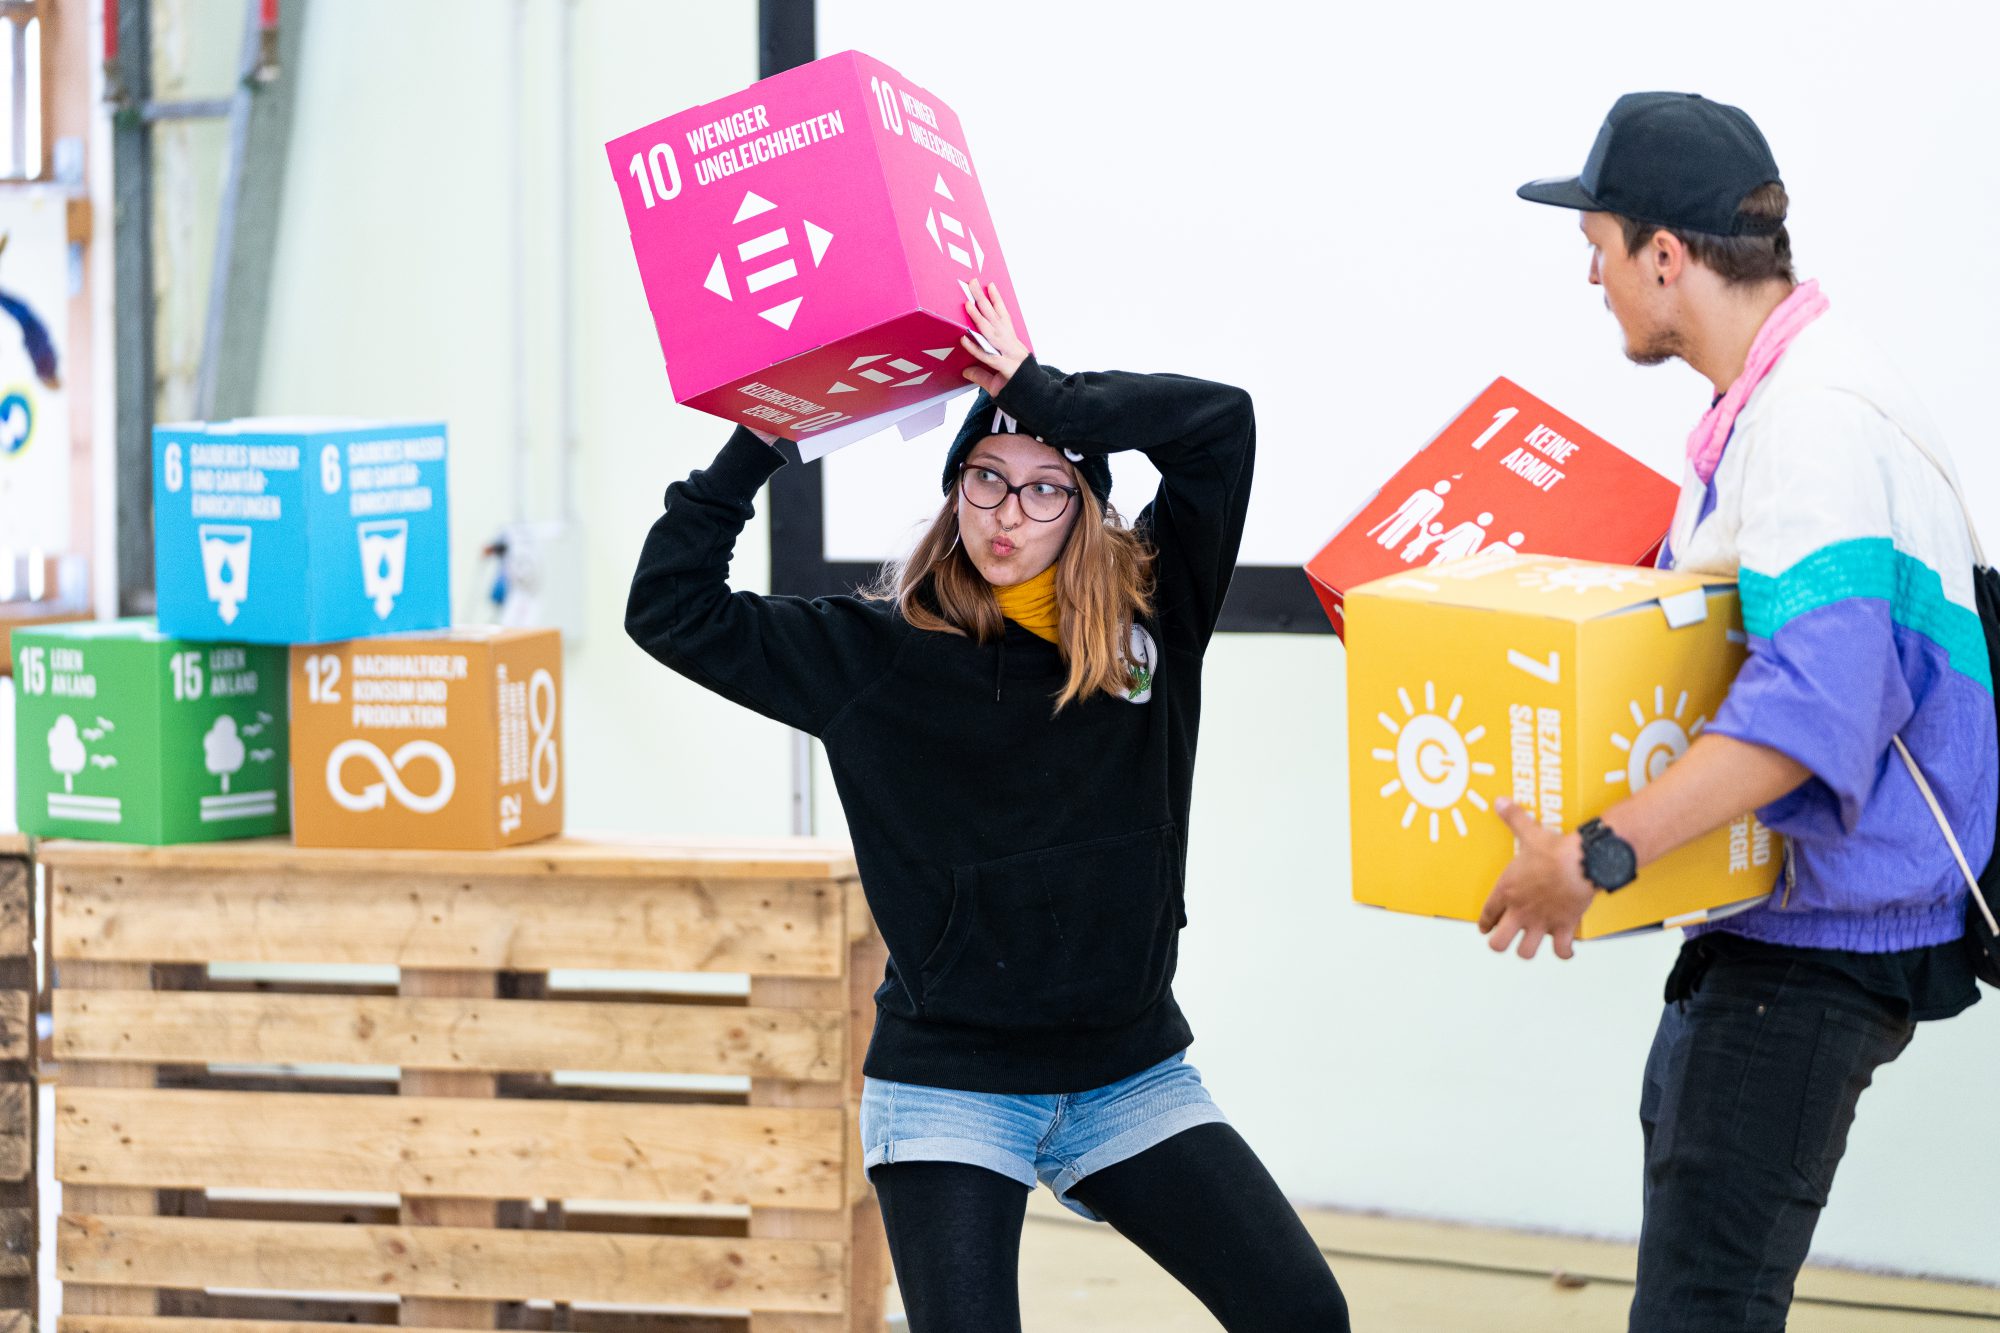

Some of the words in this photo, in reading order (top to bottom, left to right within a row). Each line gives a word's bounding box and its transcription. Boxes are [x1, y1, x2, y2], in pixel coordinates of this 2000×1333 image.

[685, 104, 770, 156] WENIGER
[871, 75, 904, 136] 10
[899, 89, 939, 131] WENIGER
[694, 109, 845, 186] UNGLEICHHEITEN
[629, 142, 682, 209] 10
[789, 411, 853, 433] 10
[1471, 406, 1520, 450] 1
[1523, 423, 1580, 465] KEINE
[164, 442, 183, 493] 6
[321, 444, 342, 494] 6
[1499, 447, 1566, 492] ARMUT
[19, 646, 46, 696] 15
[170, 651, 203, 701] 15
[304, 654, 342, 704] 12
[1507, 648, 1560, 684] 7
[1508, 703, 1536, 807] SAUBERE
[1536, 706, 1563, 834] BEZAHLBA
[501, 794, 522, 836] 12
